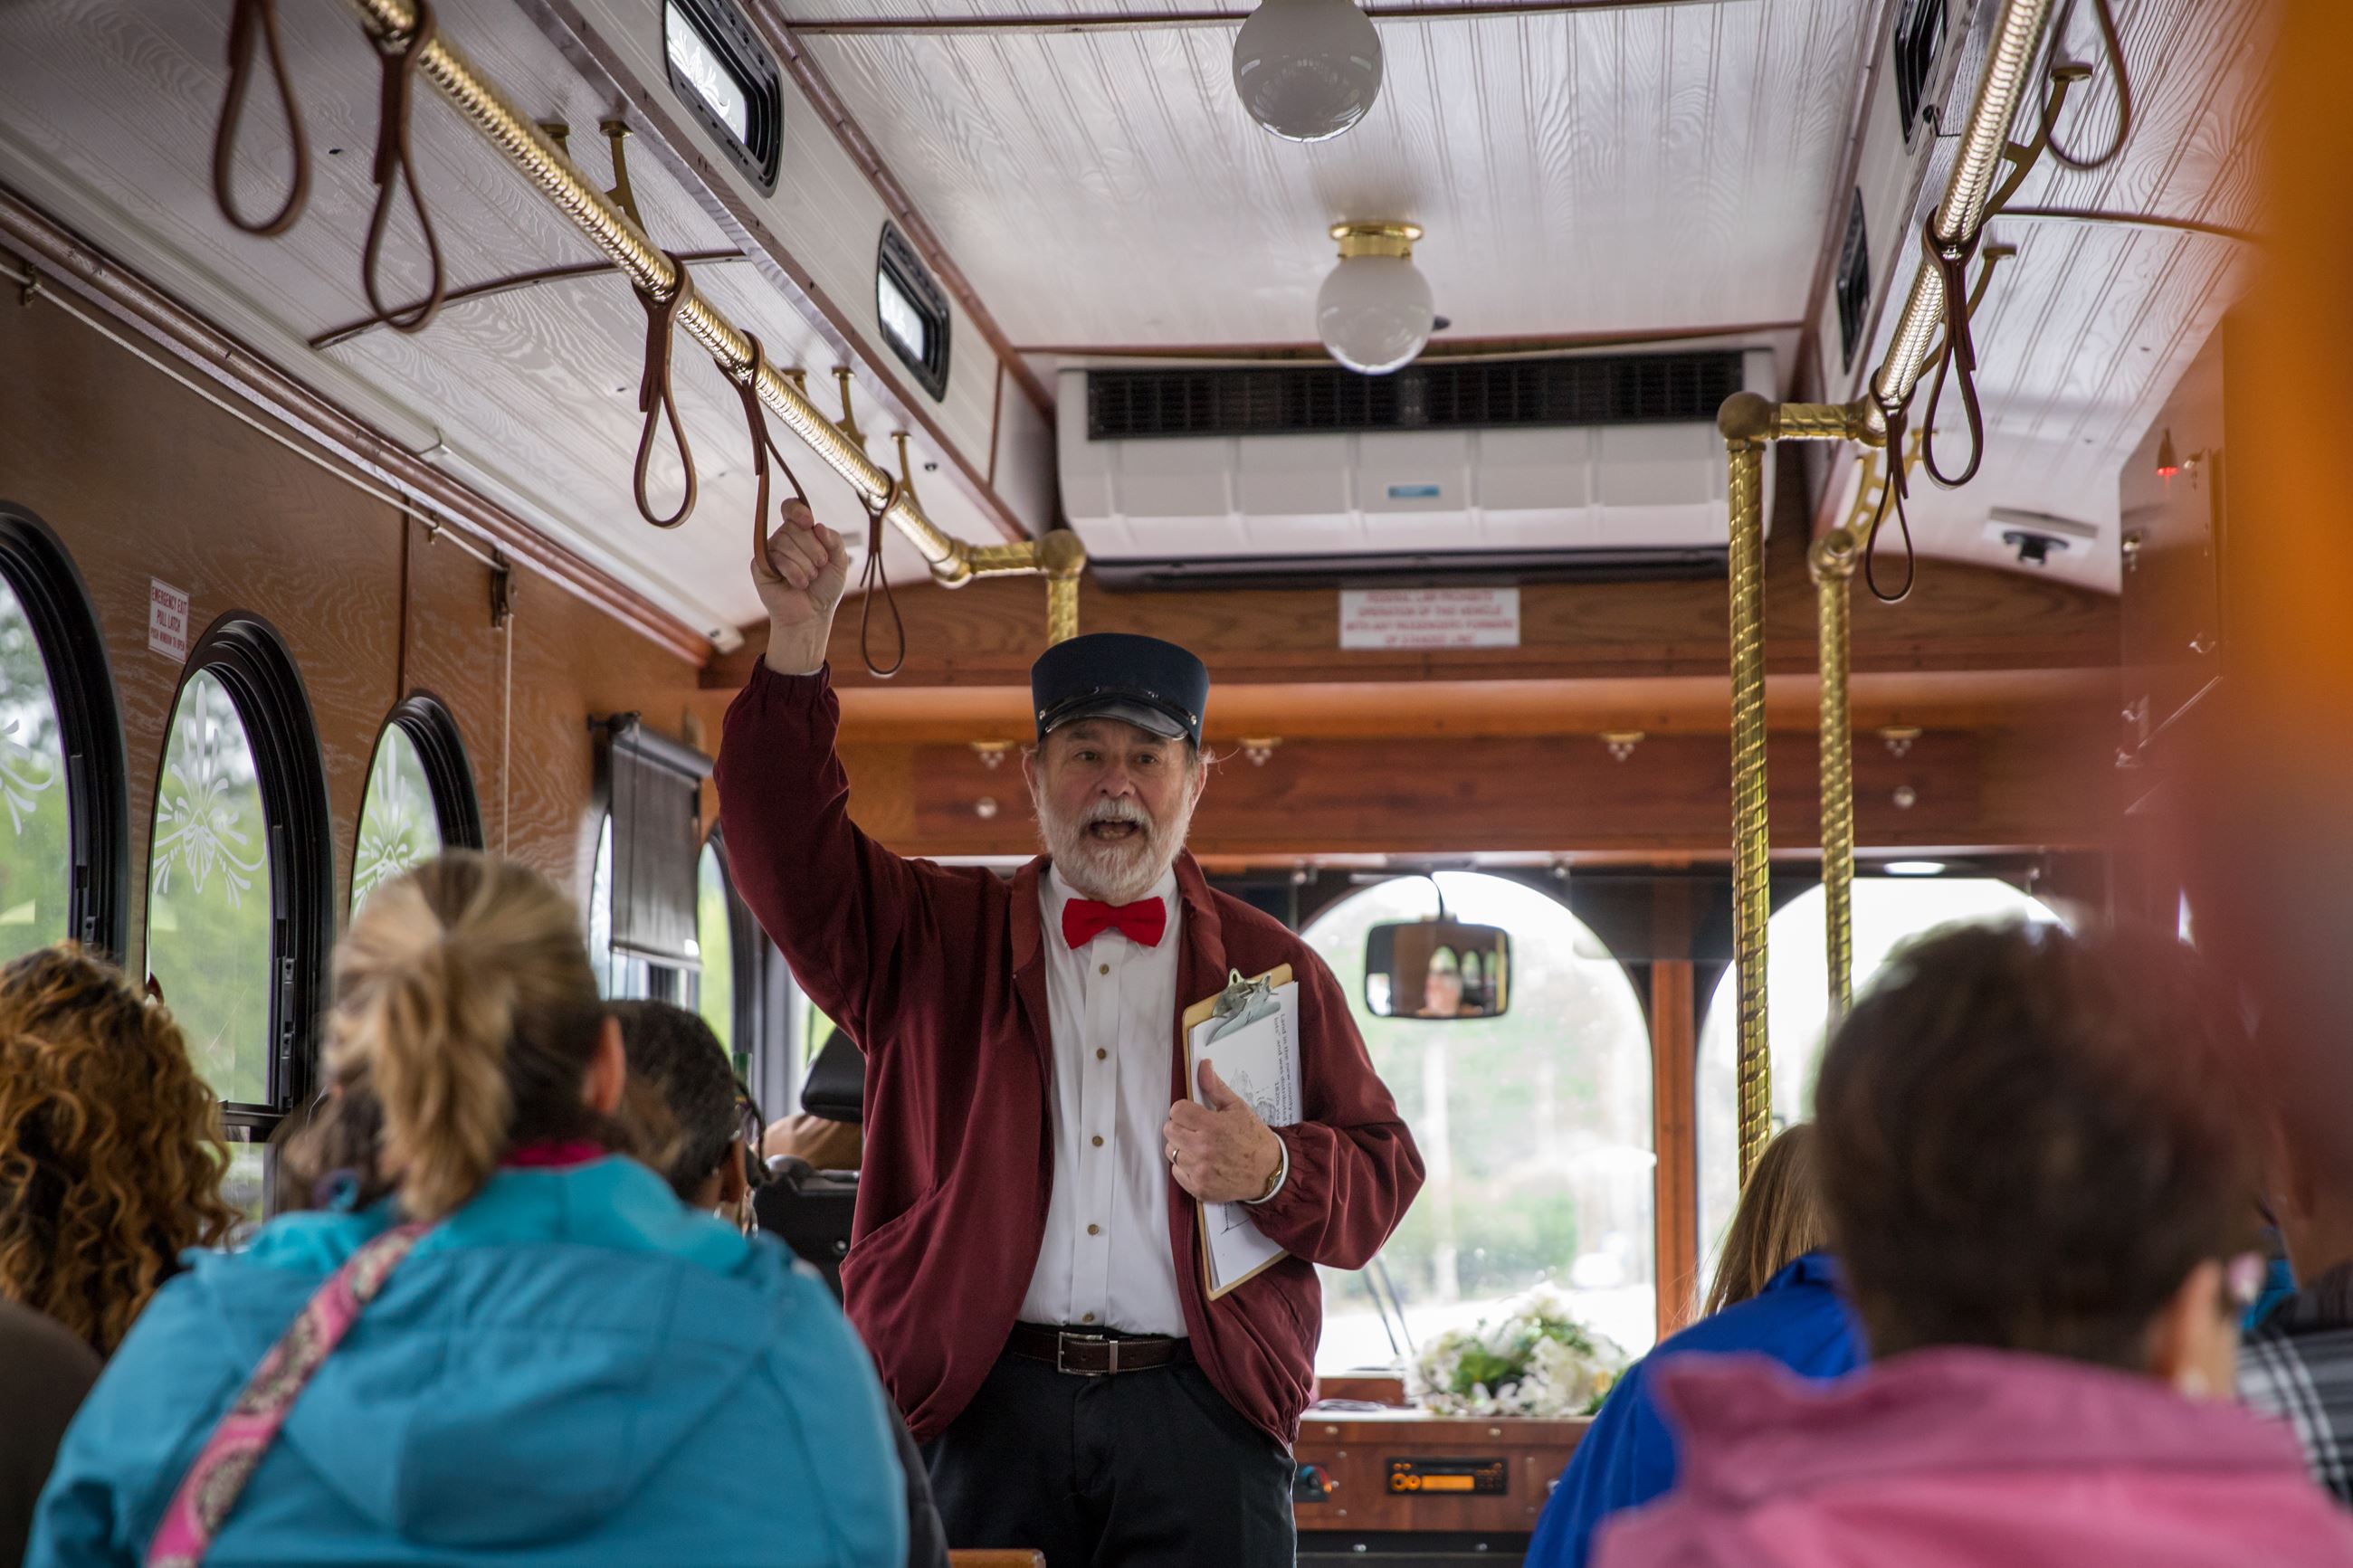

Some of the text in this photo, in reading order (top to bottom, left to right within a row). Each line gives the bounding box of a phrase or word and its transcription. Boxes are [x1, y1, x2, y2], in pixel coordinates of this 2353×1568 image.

[152, 586, 187, 615] EMERGENCY EXIT
[157, 609, 181, 632] PULL LATCH
